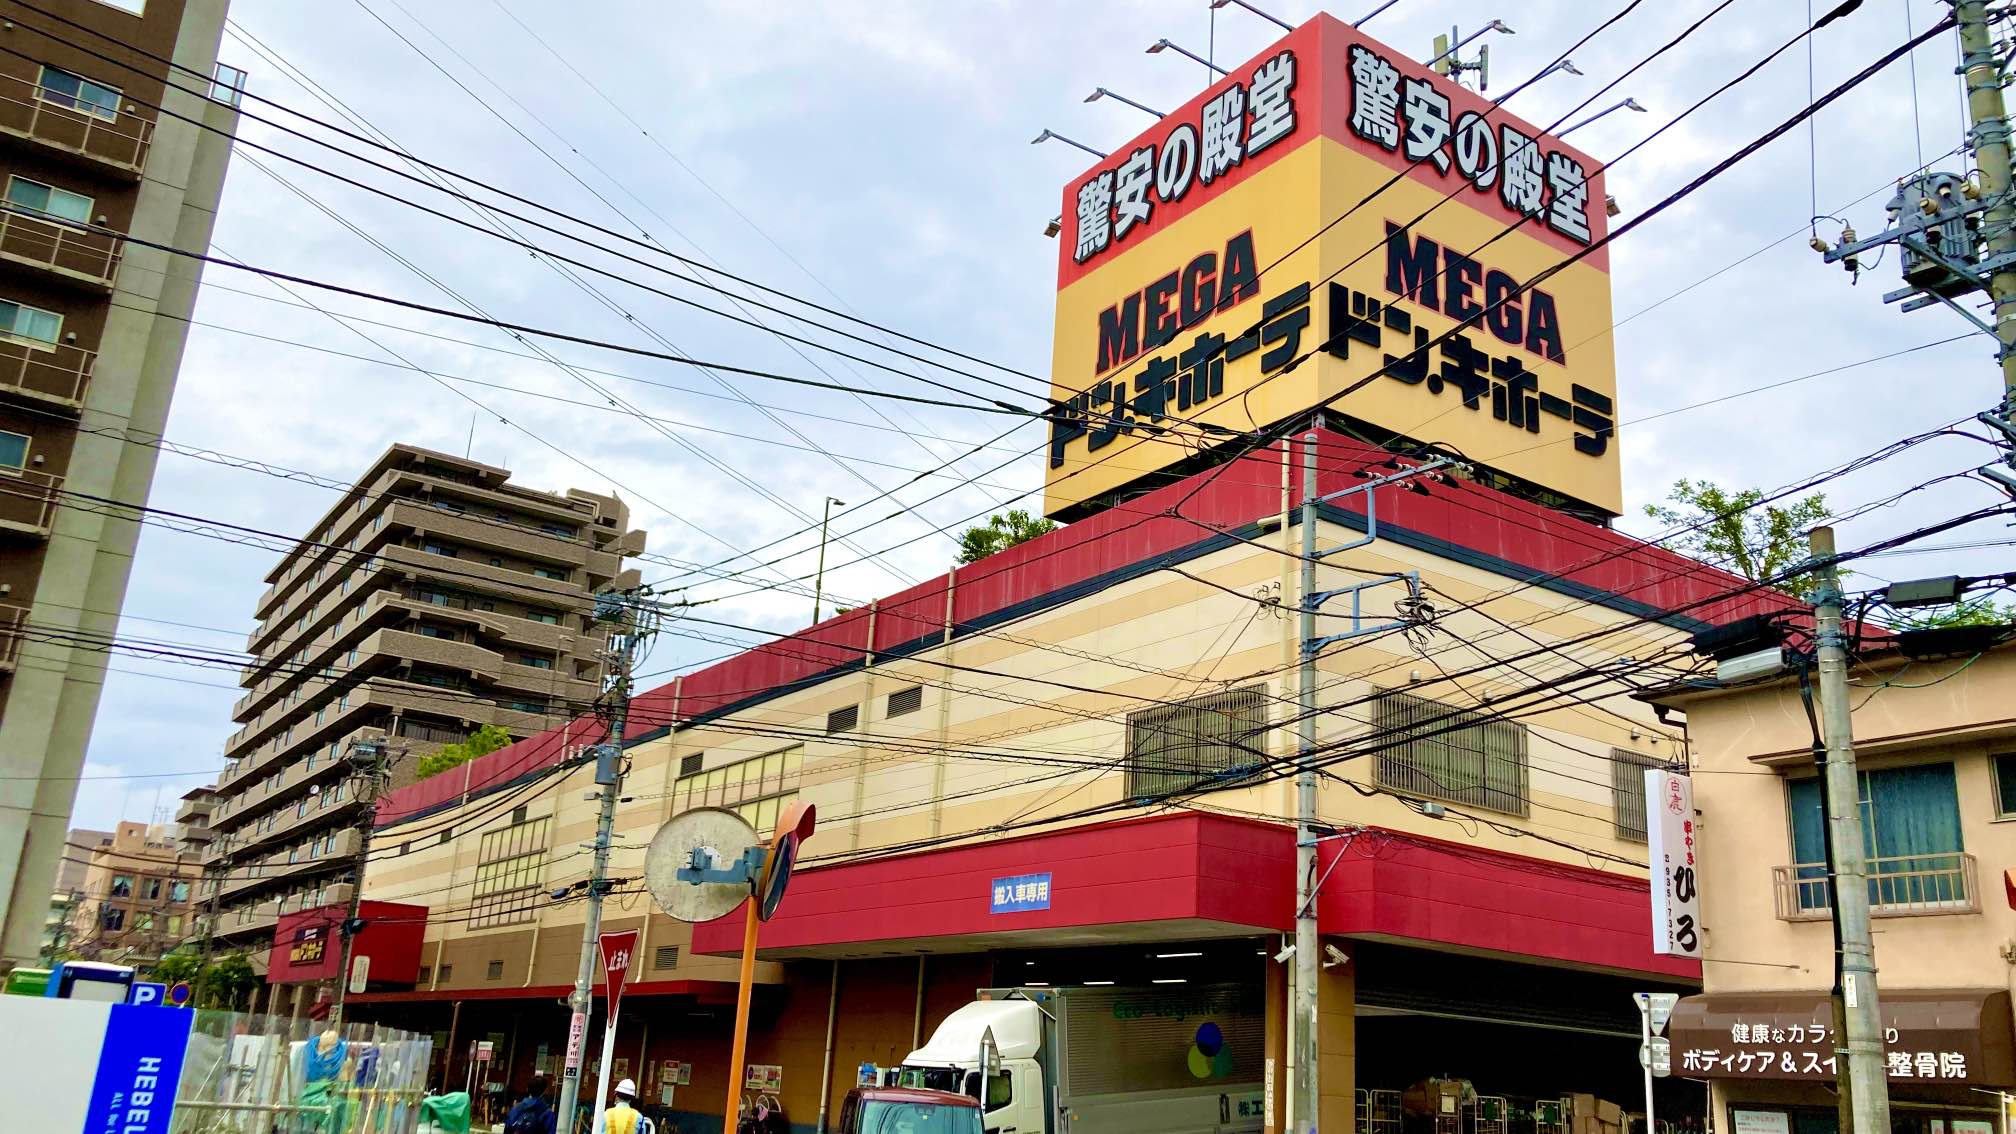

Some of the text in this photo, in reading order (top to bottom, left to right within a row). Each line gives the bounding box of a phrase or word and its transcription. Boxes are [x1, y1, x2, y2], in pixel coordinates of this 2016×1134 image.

[1073, 50, 1297, 264] 驚安の殿堂
[1347, 43, 1592, 246] 驚安の殿堂
[1095, 226, 1260, 378] MEGA
[1384, 217, 1567, 367] MEGA
[993, 881, 1049, 905] 搬入車専用
[1674, 865, 1698, 952] ひろ
[134, 986, 156, 1006] P
[608, 949, 629, 971] 止まれ
